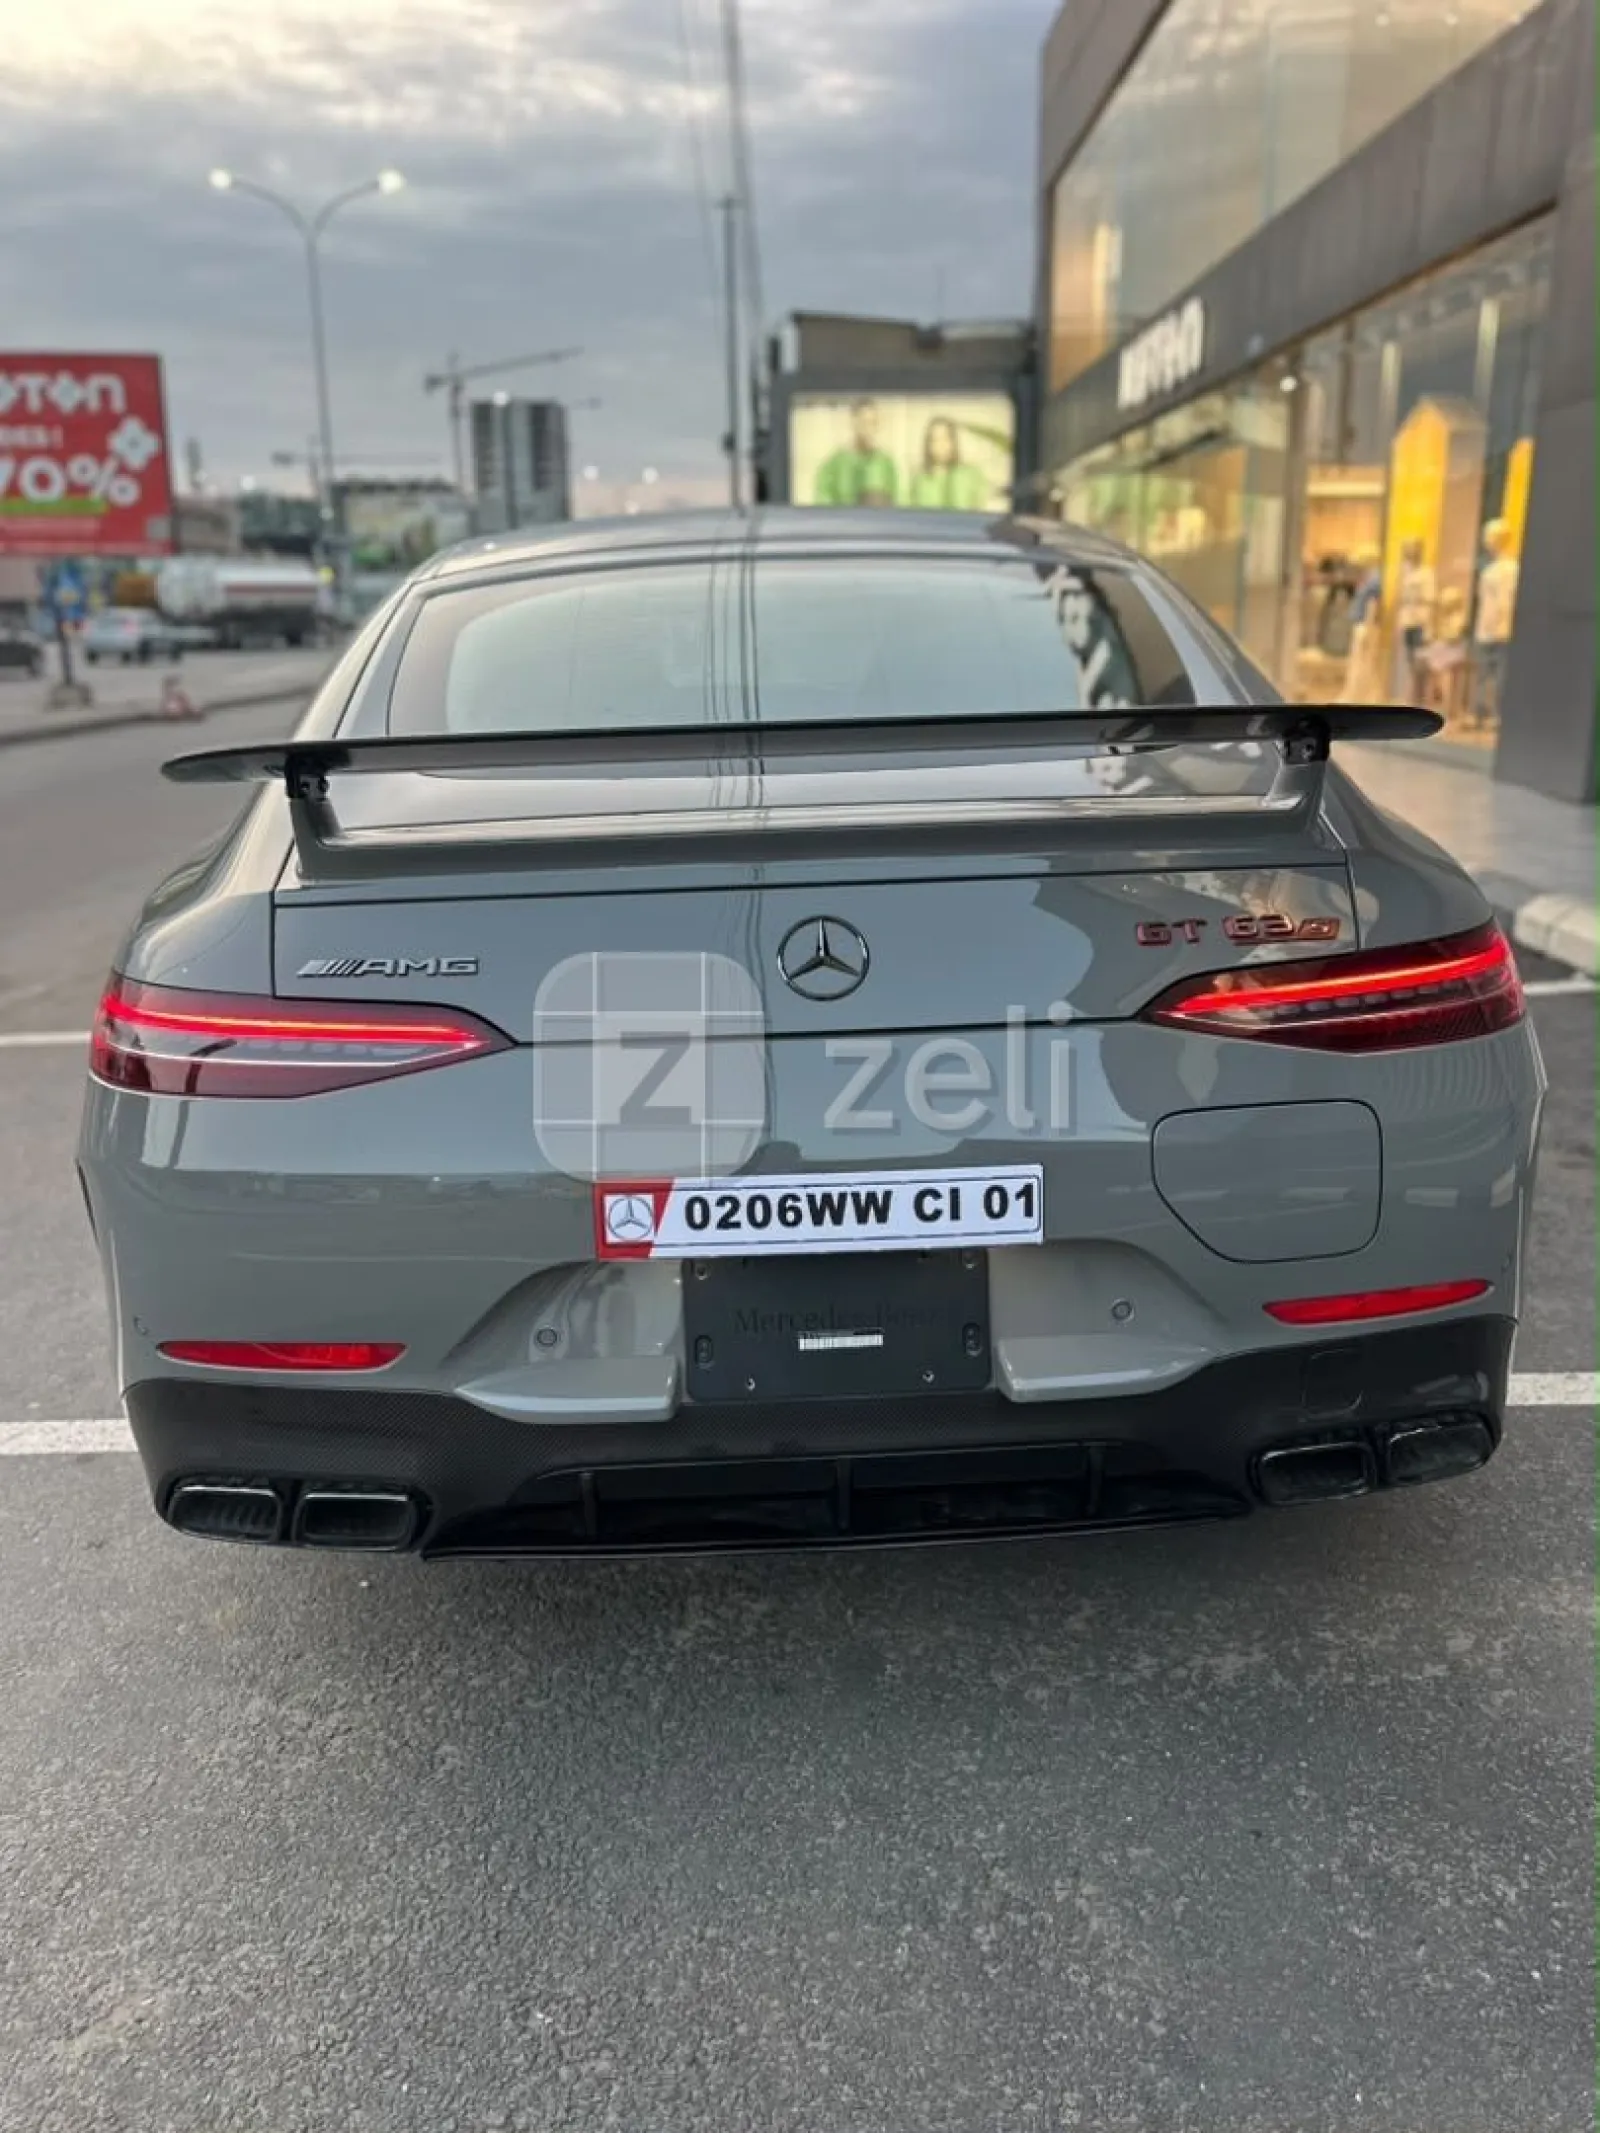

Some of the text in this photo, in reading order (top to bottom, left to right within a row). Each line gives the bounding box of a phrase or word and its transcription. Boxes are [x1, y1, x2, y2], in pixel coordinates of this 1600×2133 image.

[1135, 918, 1208, 946] GT
[684, 1182, 1035, 1231] 0206WW CI 01
